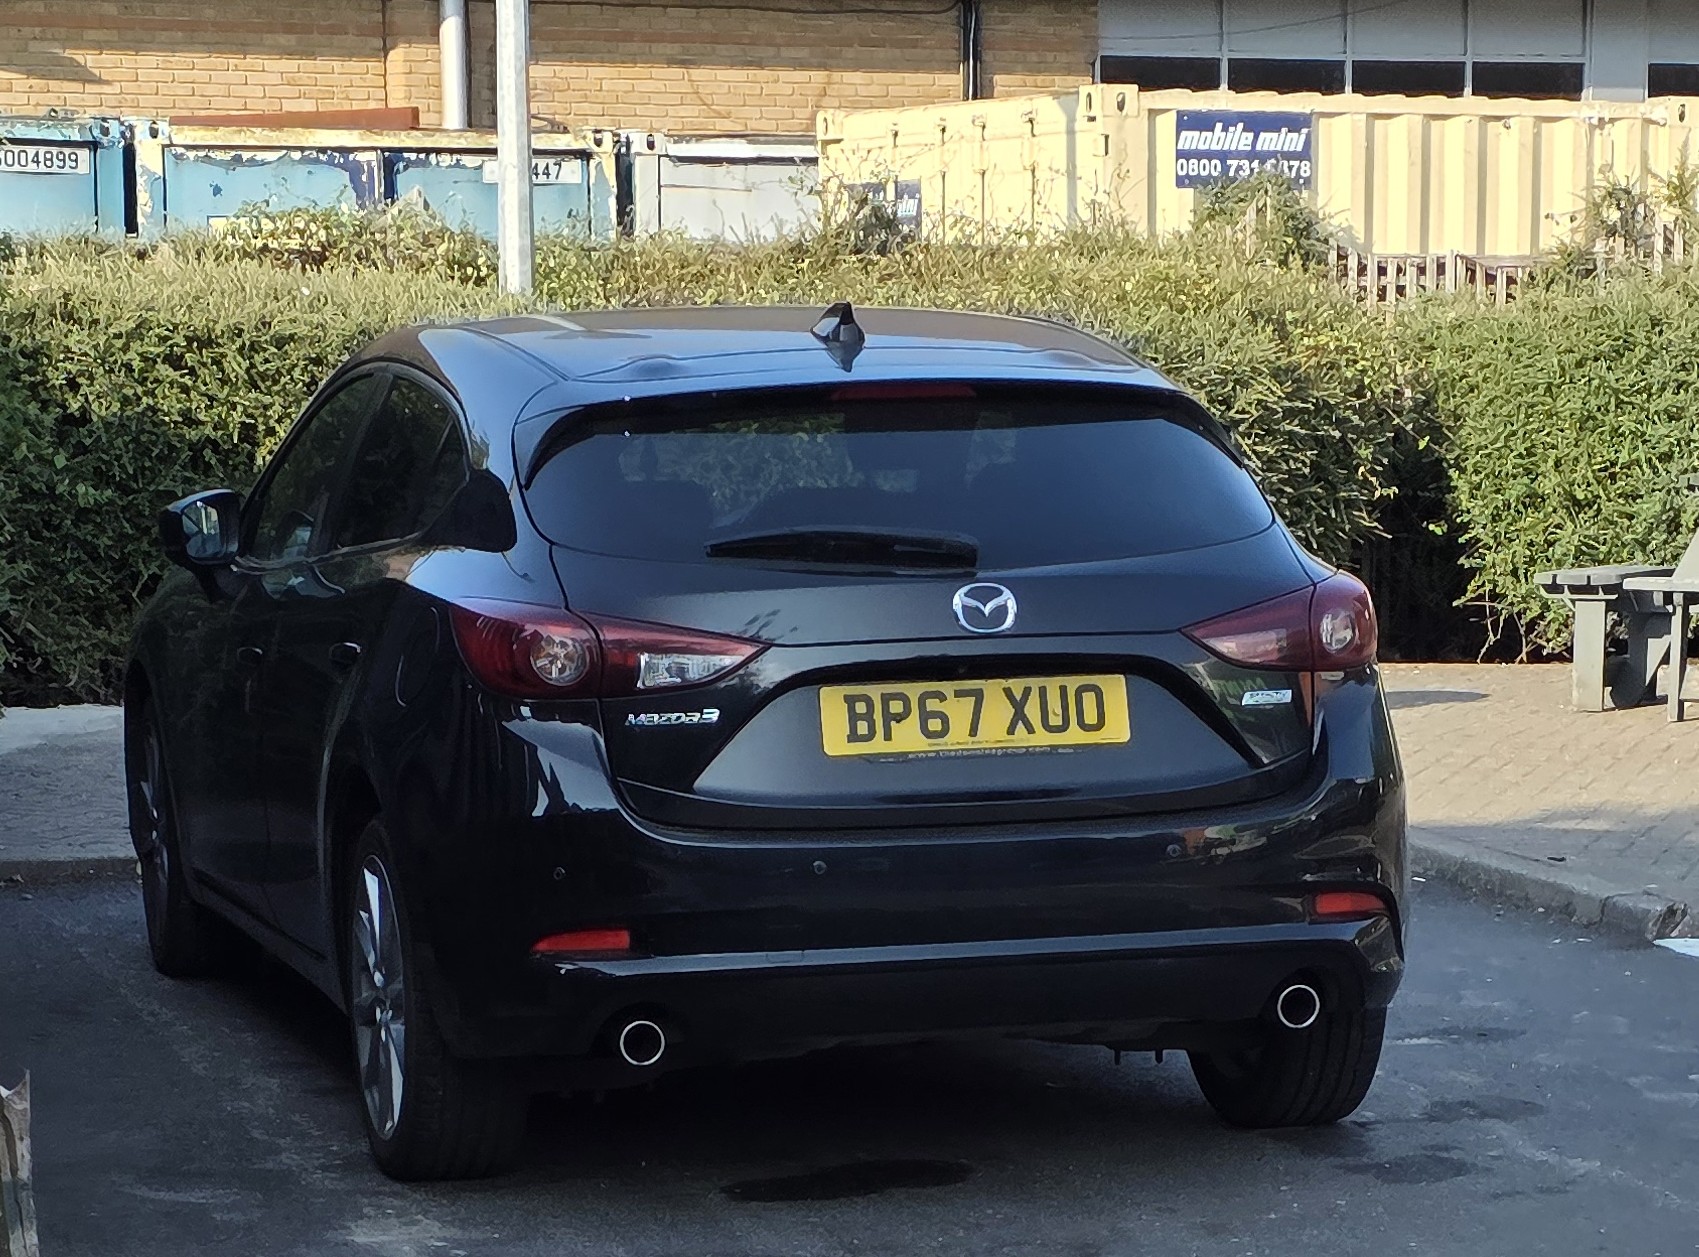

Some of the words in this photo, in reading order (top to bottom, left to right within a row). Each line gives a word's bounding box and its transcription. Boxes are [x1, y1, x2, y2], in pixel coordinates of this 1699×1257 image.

[1176, 122, 1254, 151] mobile
[1255, 127, 1309, 152] mini
[0, 149, 79, 170] 004899
[1176, 158, 1221, 176] 0800
[843, 687, 985, 744] BP67
[1002, 683, 1107, 737] XUO
